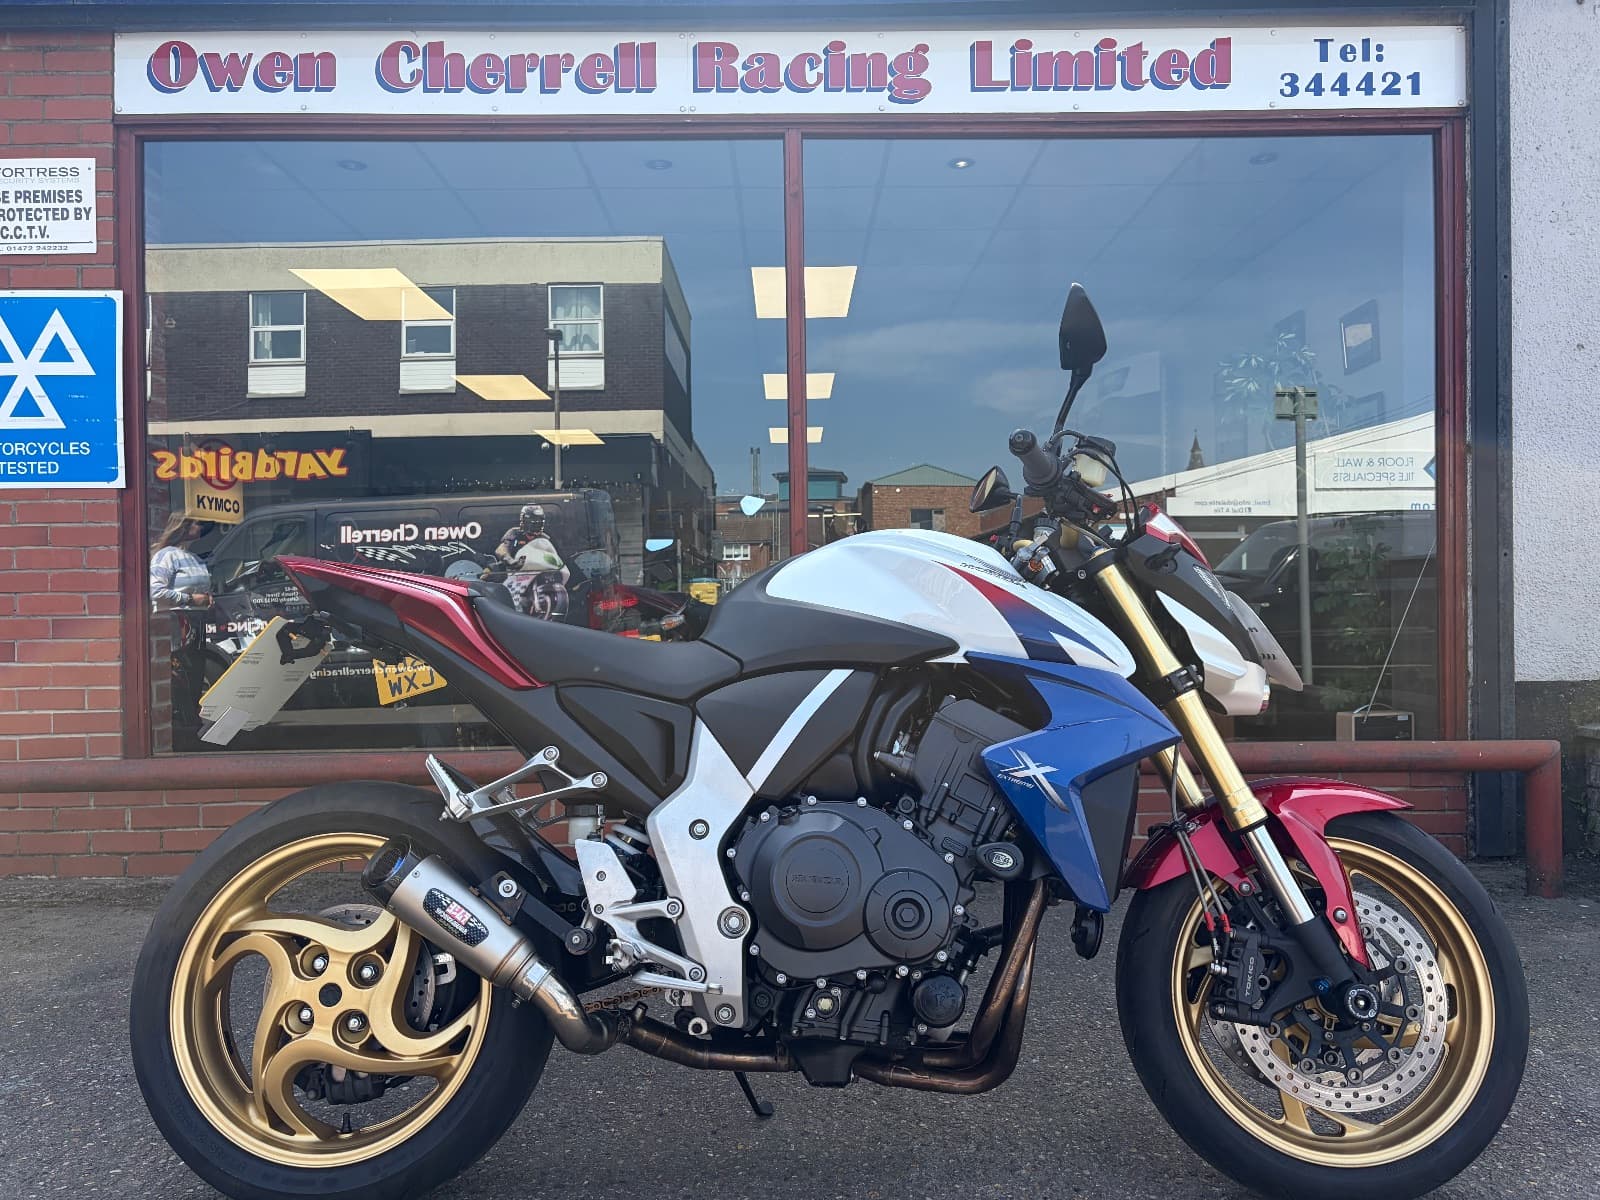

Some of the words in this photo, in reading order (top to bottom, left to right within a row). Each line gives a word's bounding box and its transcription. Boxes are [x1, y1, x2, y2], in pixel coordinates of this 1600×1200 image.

[1313, 38, 1384, 63] Tel:
[147, 40, 336, 94] Owen
[376, 40, 657, 95] Cherrell
[692, 40, 933, 104] Racing
[970, 37, 1233, 93] Limited
[1279, 72, 1421, 98] 344421
[0, 167, 80, 177] ORTRESS
[14, 189, 83, 204] PREMISES
[73, 206, 92, 221] BY
[197, 494, 240, 514] KYMCO
[1244, 957, 1255, 997] TOKICO
